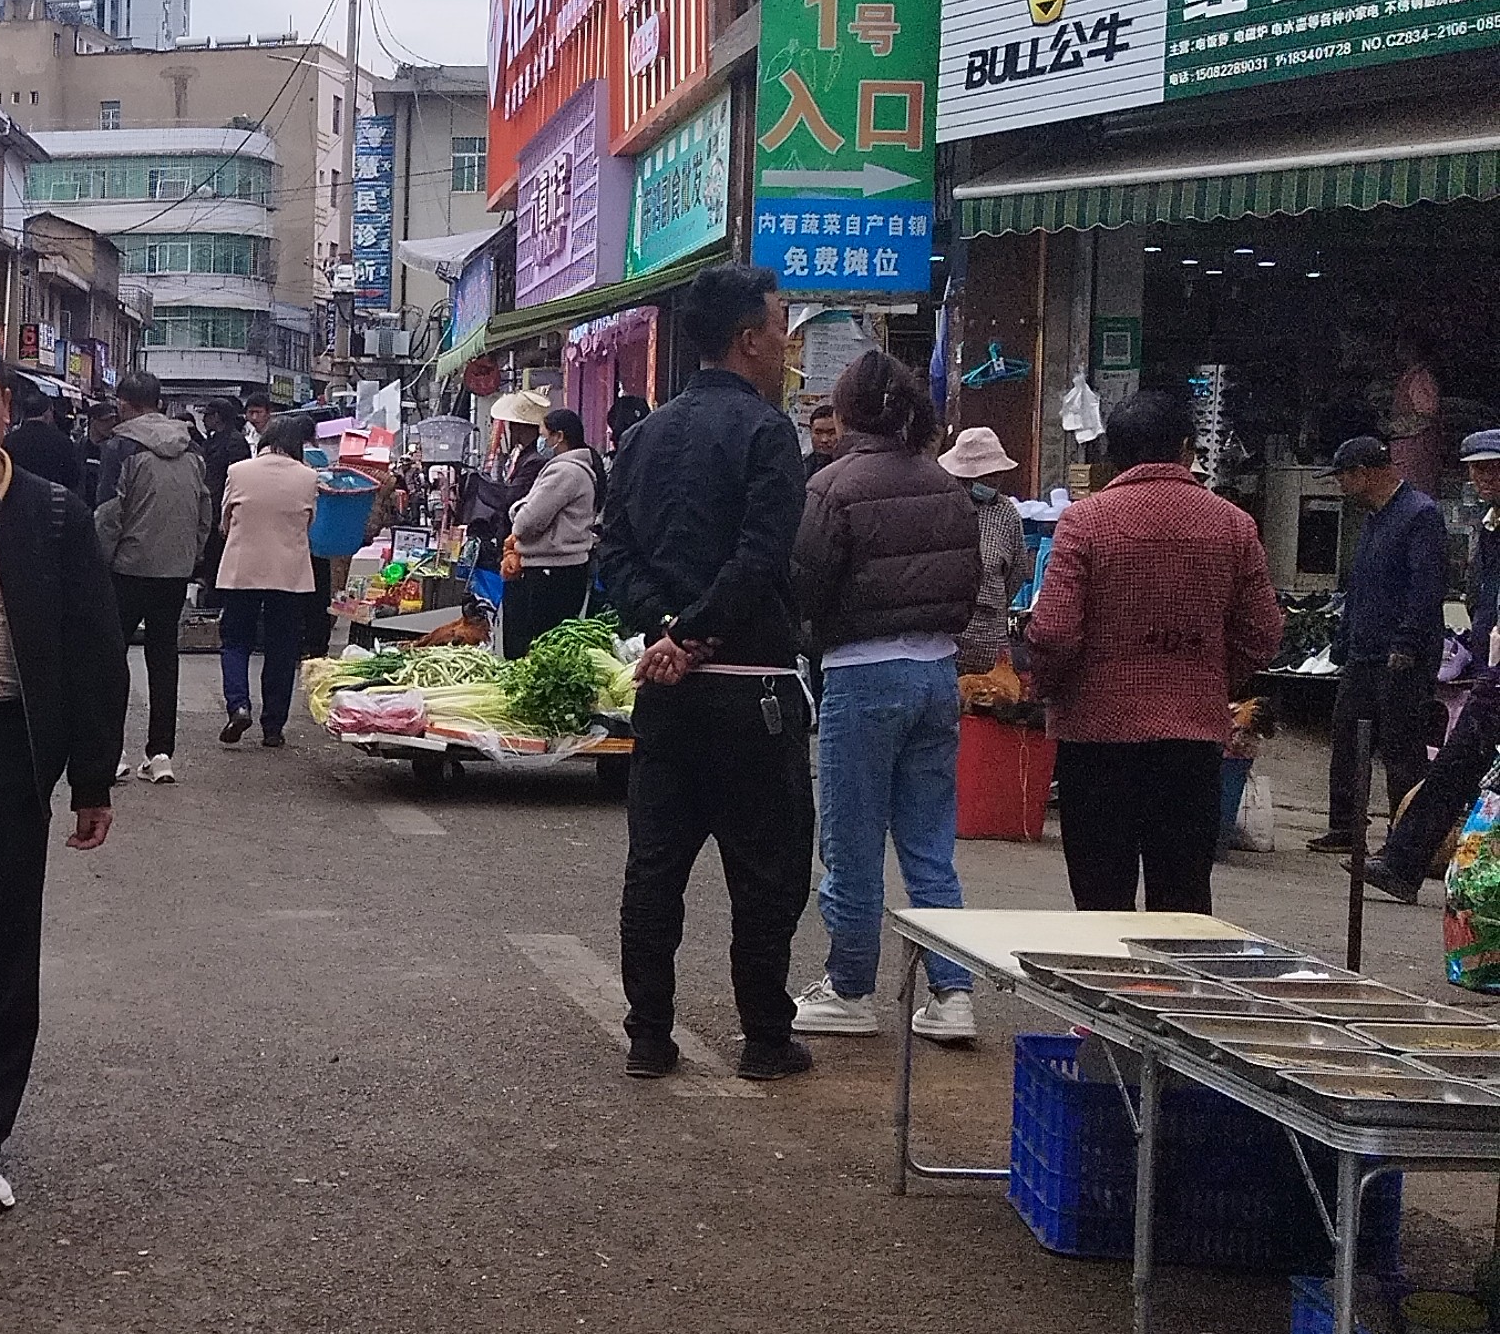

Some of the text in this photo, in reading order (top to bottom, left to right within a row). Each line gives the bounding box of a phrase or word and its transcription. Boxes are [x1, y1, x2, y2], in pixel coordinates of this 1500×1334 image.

[758, 69, 925, 155] 入口
[757, 214, 928, 237] 内有蔬菜自产自销
[783, 246, 900, 277] 免费摊位
